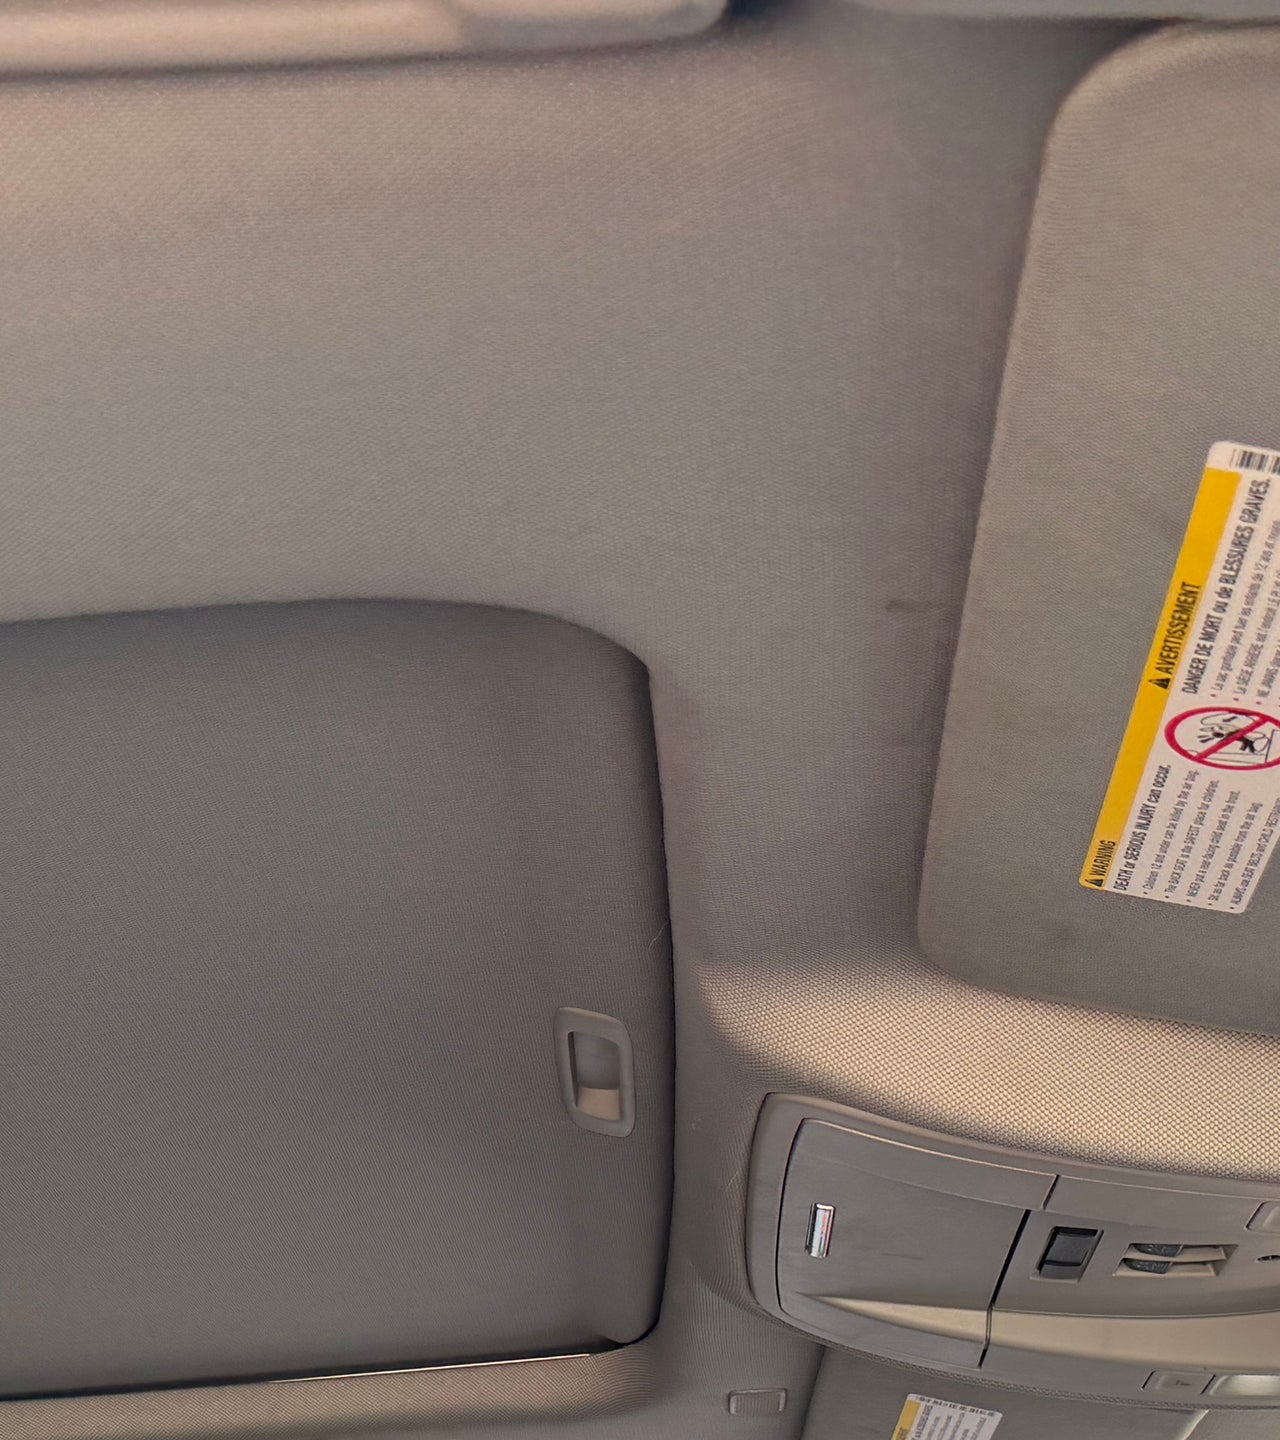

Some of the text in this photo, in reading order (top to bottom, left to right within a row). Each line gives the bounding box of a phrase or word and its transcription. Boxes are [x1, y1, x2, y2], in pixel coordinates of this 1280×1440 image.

[1156, 581, 1200, 674] AVERTISSEMENT
[1182, 478, 1271, 694] DANGER DE MORT ou de BLESSURES GRAVES.
[1090, 840, 1116, 876] WARNING
[1113, 765, 1171, 891] DEATH or SERIOUS INJURY can occur.
